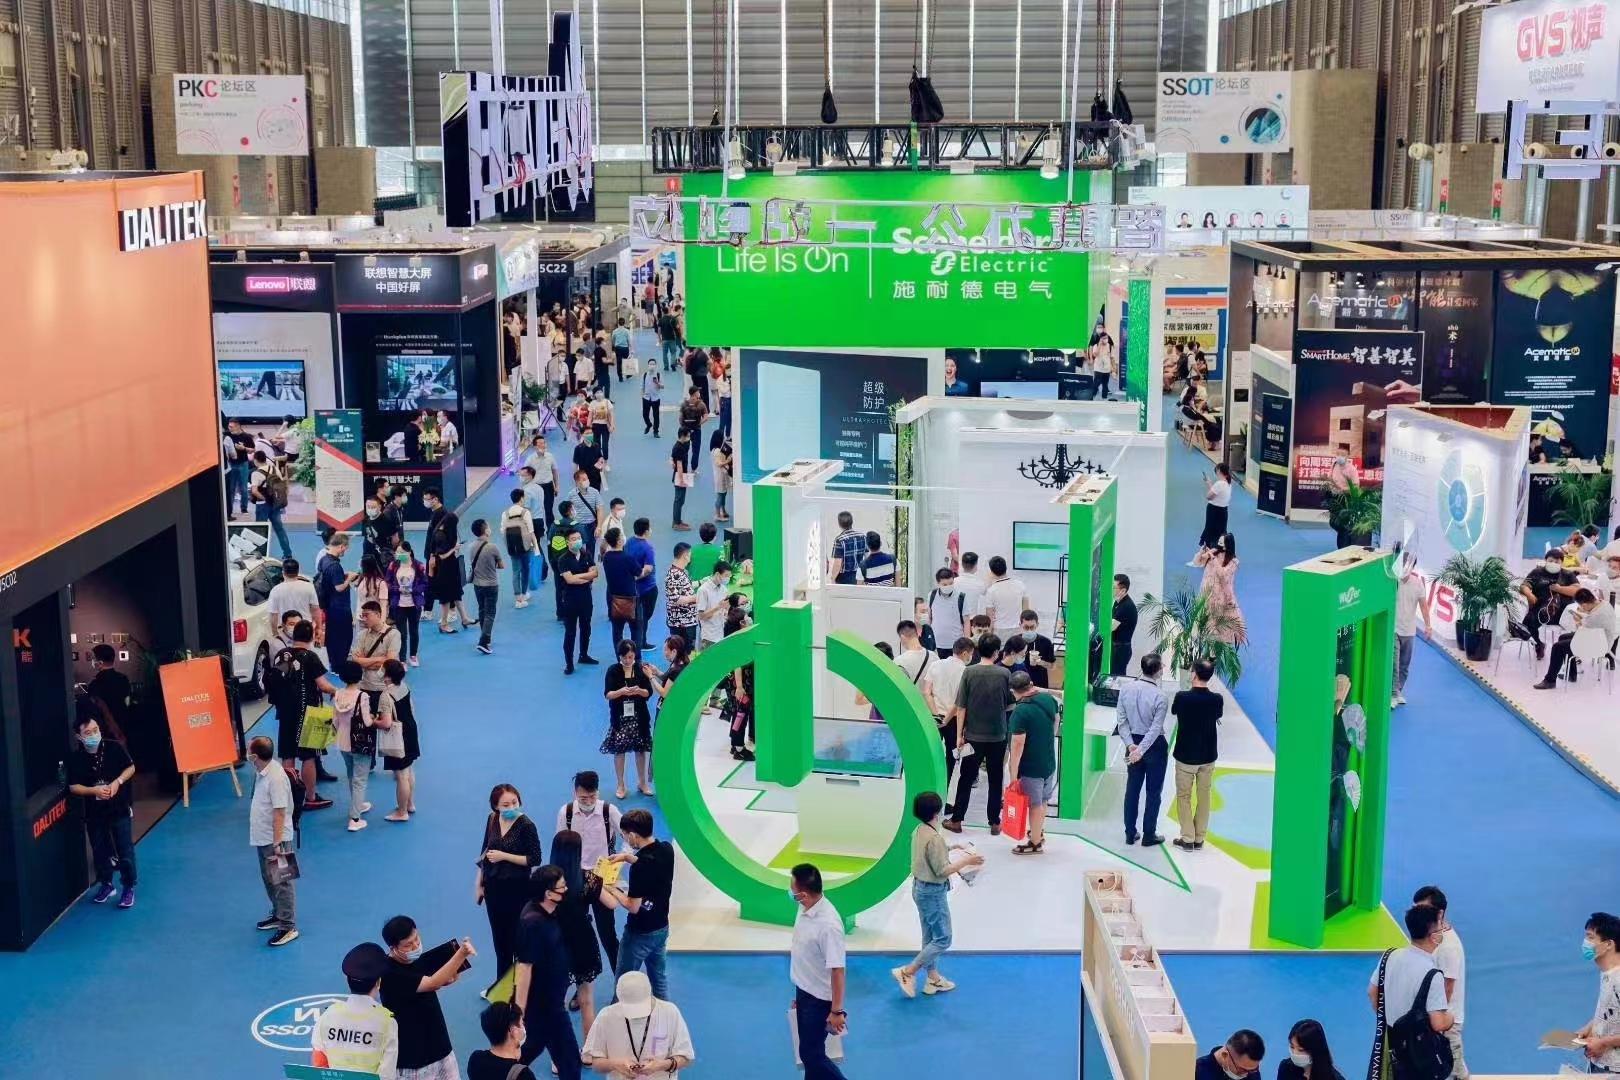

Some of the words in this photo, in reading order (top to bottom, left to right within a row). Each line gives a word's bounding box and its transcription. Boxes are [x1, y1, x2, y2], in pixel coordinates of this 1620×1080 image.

[1517, 11, 1566, 62] GVS
[179, 80, 217, 98] PKC
[221, 80, 257, 92] 论坛区
[1162, 78, 1213, 96] SSOT
[1216, 77, 1250, 90] 论坛区
[123, 199, 207, 252] DALITEK
[539, 263, 567, 274] 5C22
[717, 246, 767, 273] Life
[775, 246, 797, 273] Is
[804, 246, 849, 273] On
[960, 257, 1048, 273] Electric
[364, 267, 432, 279] 联想智慧大屏
[249, 279, 286, 290] Lenovo
[290, 277, 316, 291] 联想
[375, 281, 421, 293] 中国好屏
[892, 280, 1053, 299] 施耐德电气
[1351, 345, 1417, 366] 智善智美
[1524, 347, 1572, 356] Acematic
[863, 381, 885, 395] 超级
[863, 396, 885, 410] 防护
[0, 571, 18, 592] 5C02
[33, 798, 69, 840] DALITEK
[260, 1024, 316, 1036] SSO
[327, 1027, 373, 1046] SNIEC
